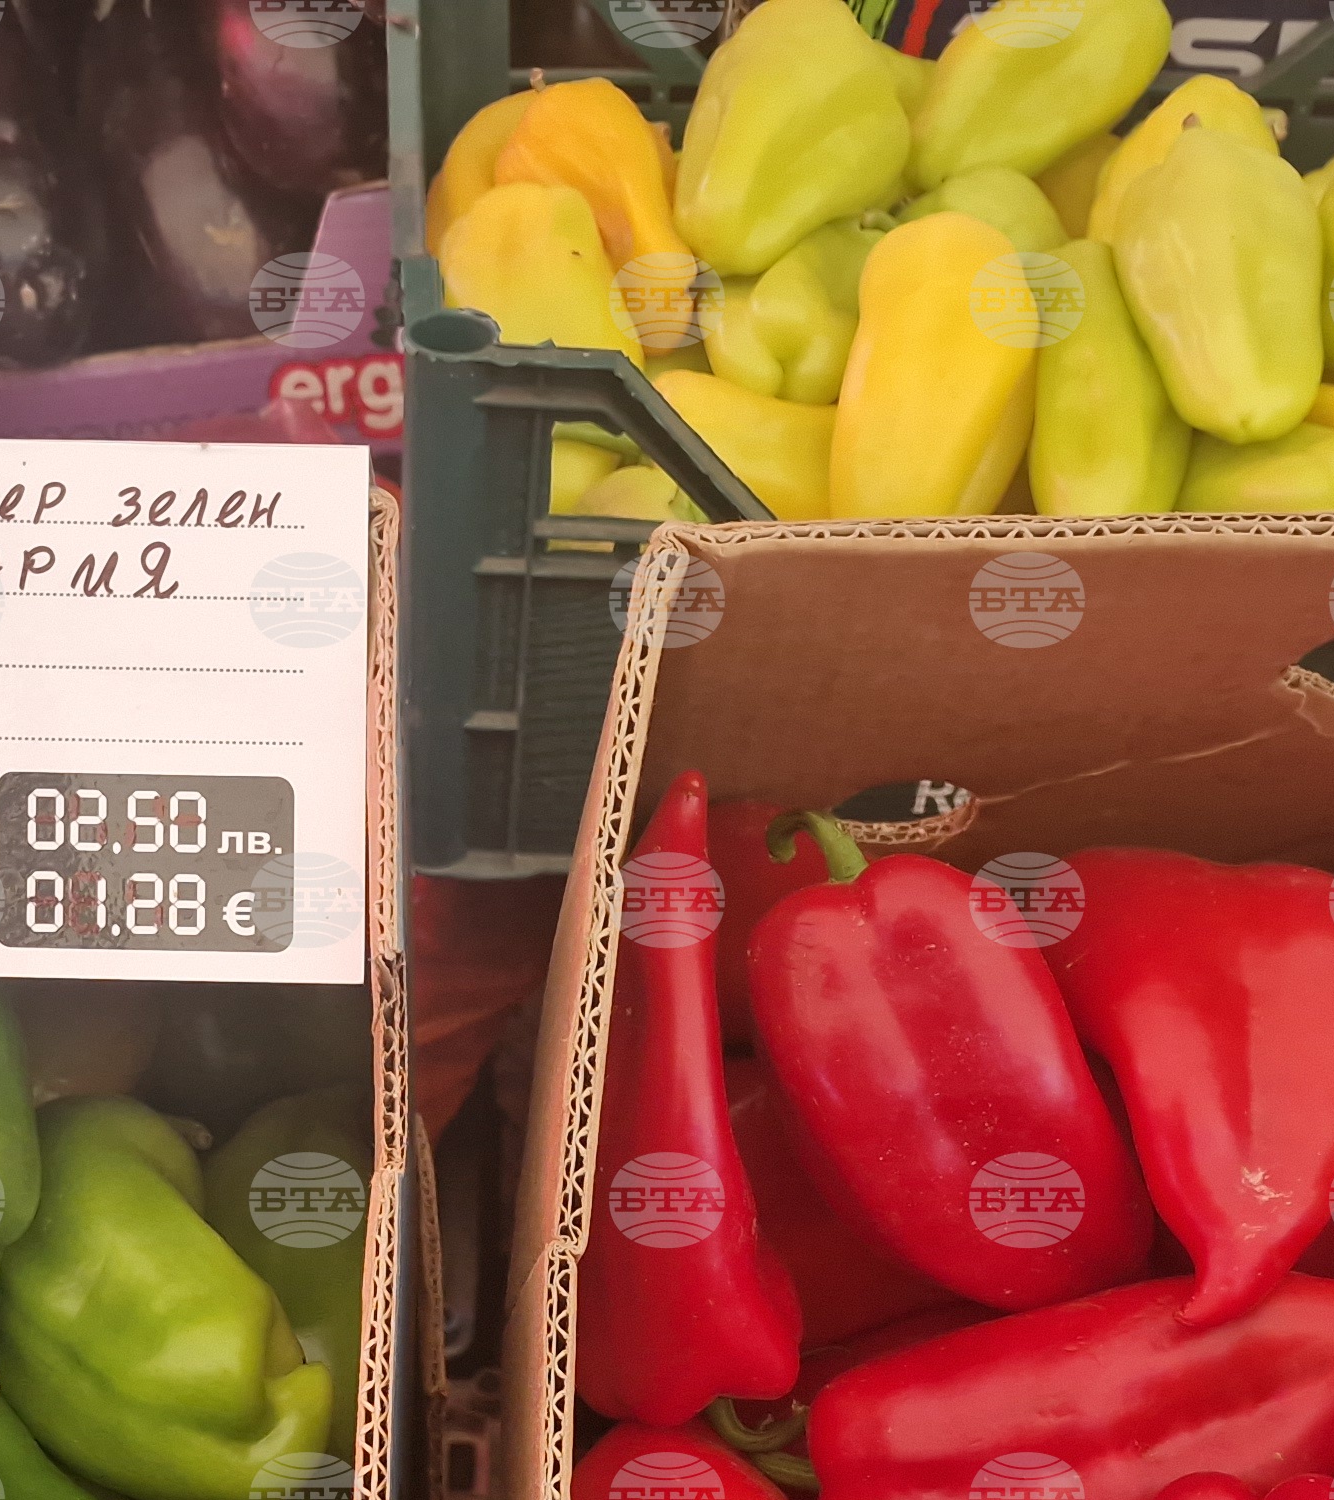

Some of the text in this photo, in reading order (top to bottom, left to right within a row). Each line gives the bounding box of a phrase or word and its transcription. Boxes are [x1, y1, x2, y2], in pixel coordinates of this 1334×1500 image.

[27, 788, 283, 855] 02.50 лв.
[26, 870, 256, 936] 01.28 €
